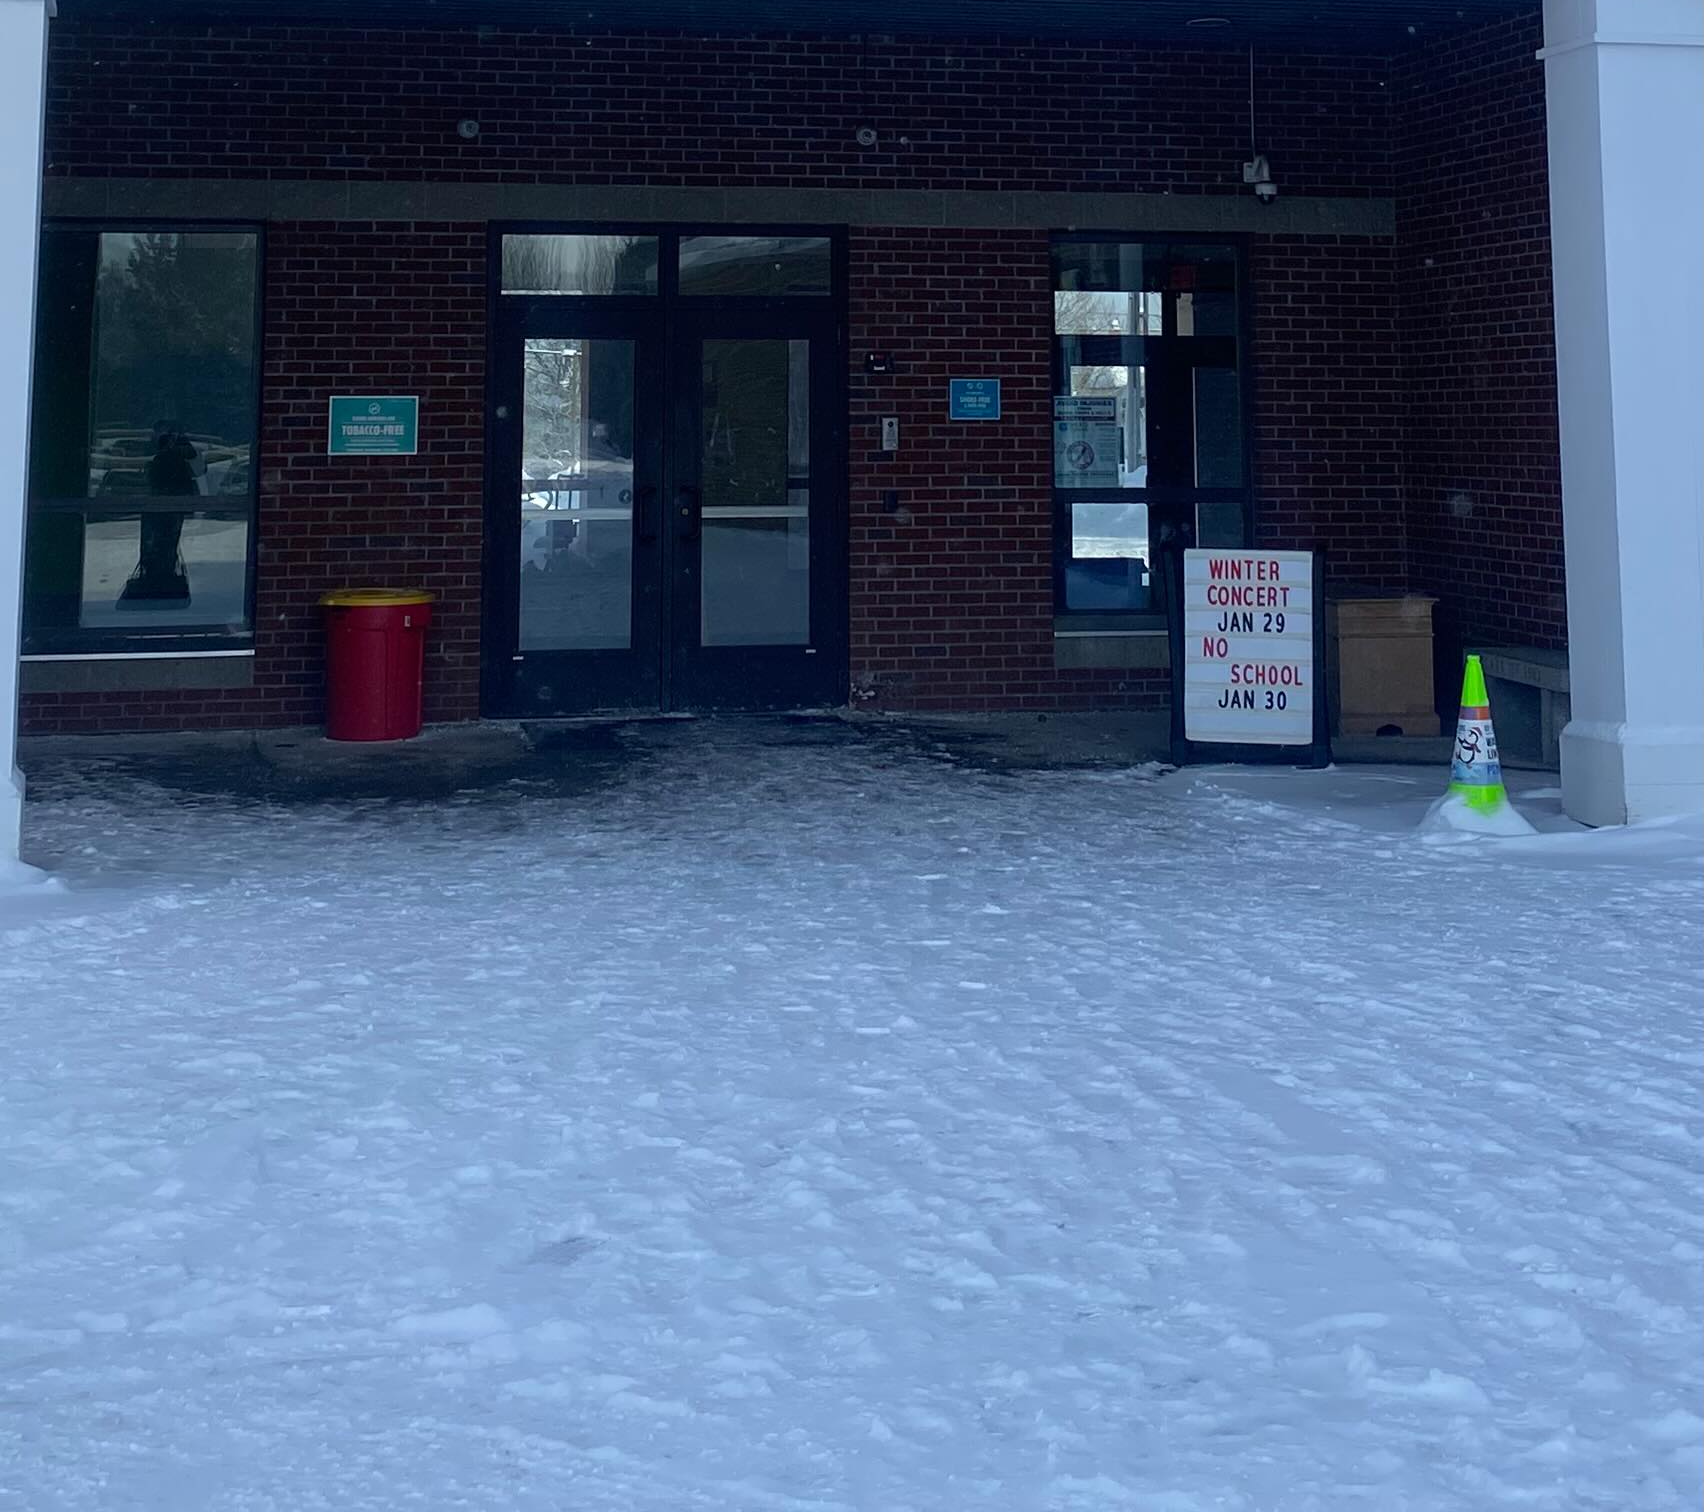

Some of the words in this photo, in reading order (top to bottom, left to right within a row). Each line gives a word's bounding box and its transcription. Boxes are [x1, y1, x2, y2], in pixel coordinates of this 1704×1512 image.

[342, 424, 405, 436] TOBACCO-FREE
[1209, 559, 1280, 581] WINTER
[1207, 584, 1291, 608] CONCERT
[1217, 611, 1254, 633] JAN
[1263, 612, 1286, 634] 29
[1203, 636, 1229, 658] NO
[1231, 663, 1304, 687] SCHOOL
[1217, 688, 1256, 710] JAN
[1264, 690, 1288, 711] 30
